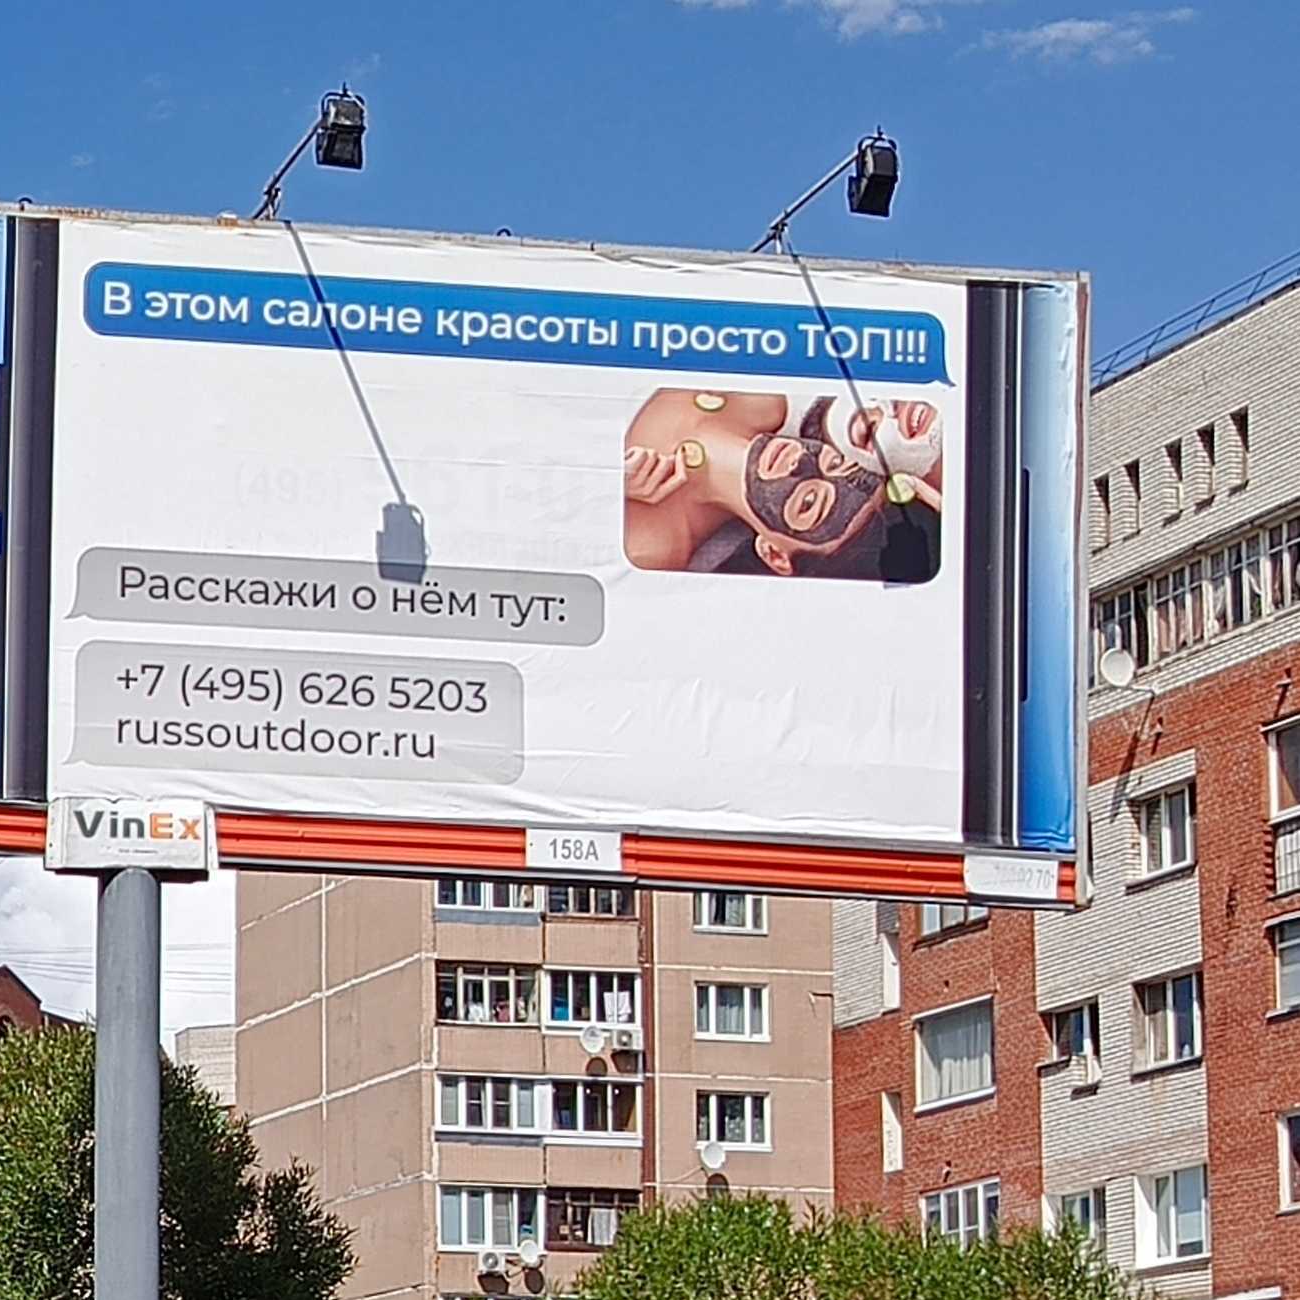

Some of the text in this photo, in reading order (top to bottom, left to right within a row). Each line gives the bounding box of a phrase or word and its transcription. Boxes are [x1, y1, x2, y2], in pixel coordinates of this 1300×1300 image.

[103, 281, 928, 364] В этом салоне красоты просто ТОП!!!
[119, 565, 567, 628] Расскажи о нём тут:
[116, 664, 488, 713] +7 (495) 626 5203
[117, 717, 436, 759] russoutdoor.ru
[73, 810, 201, 840] VinEx
